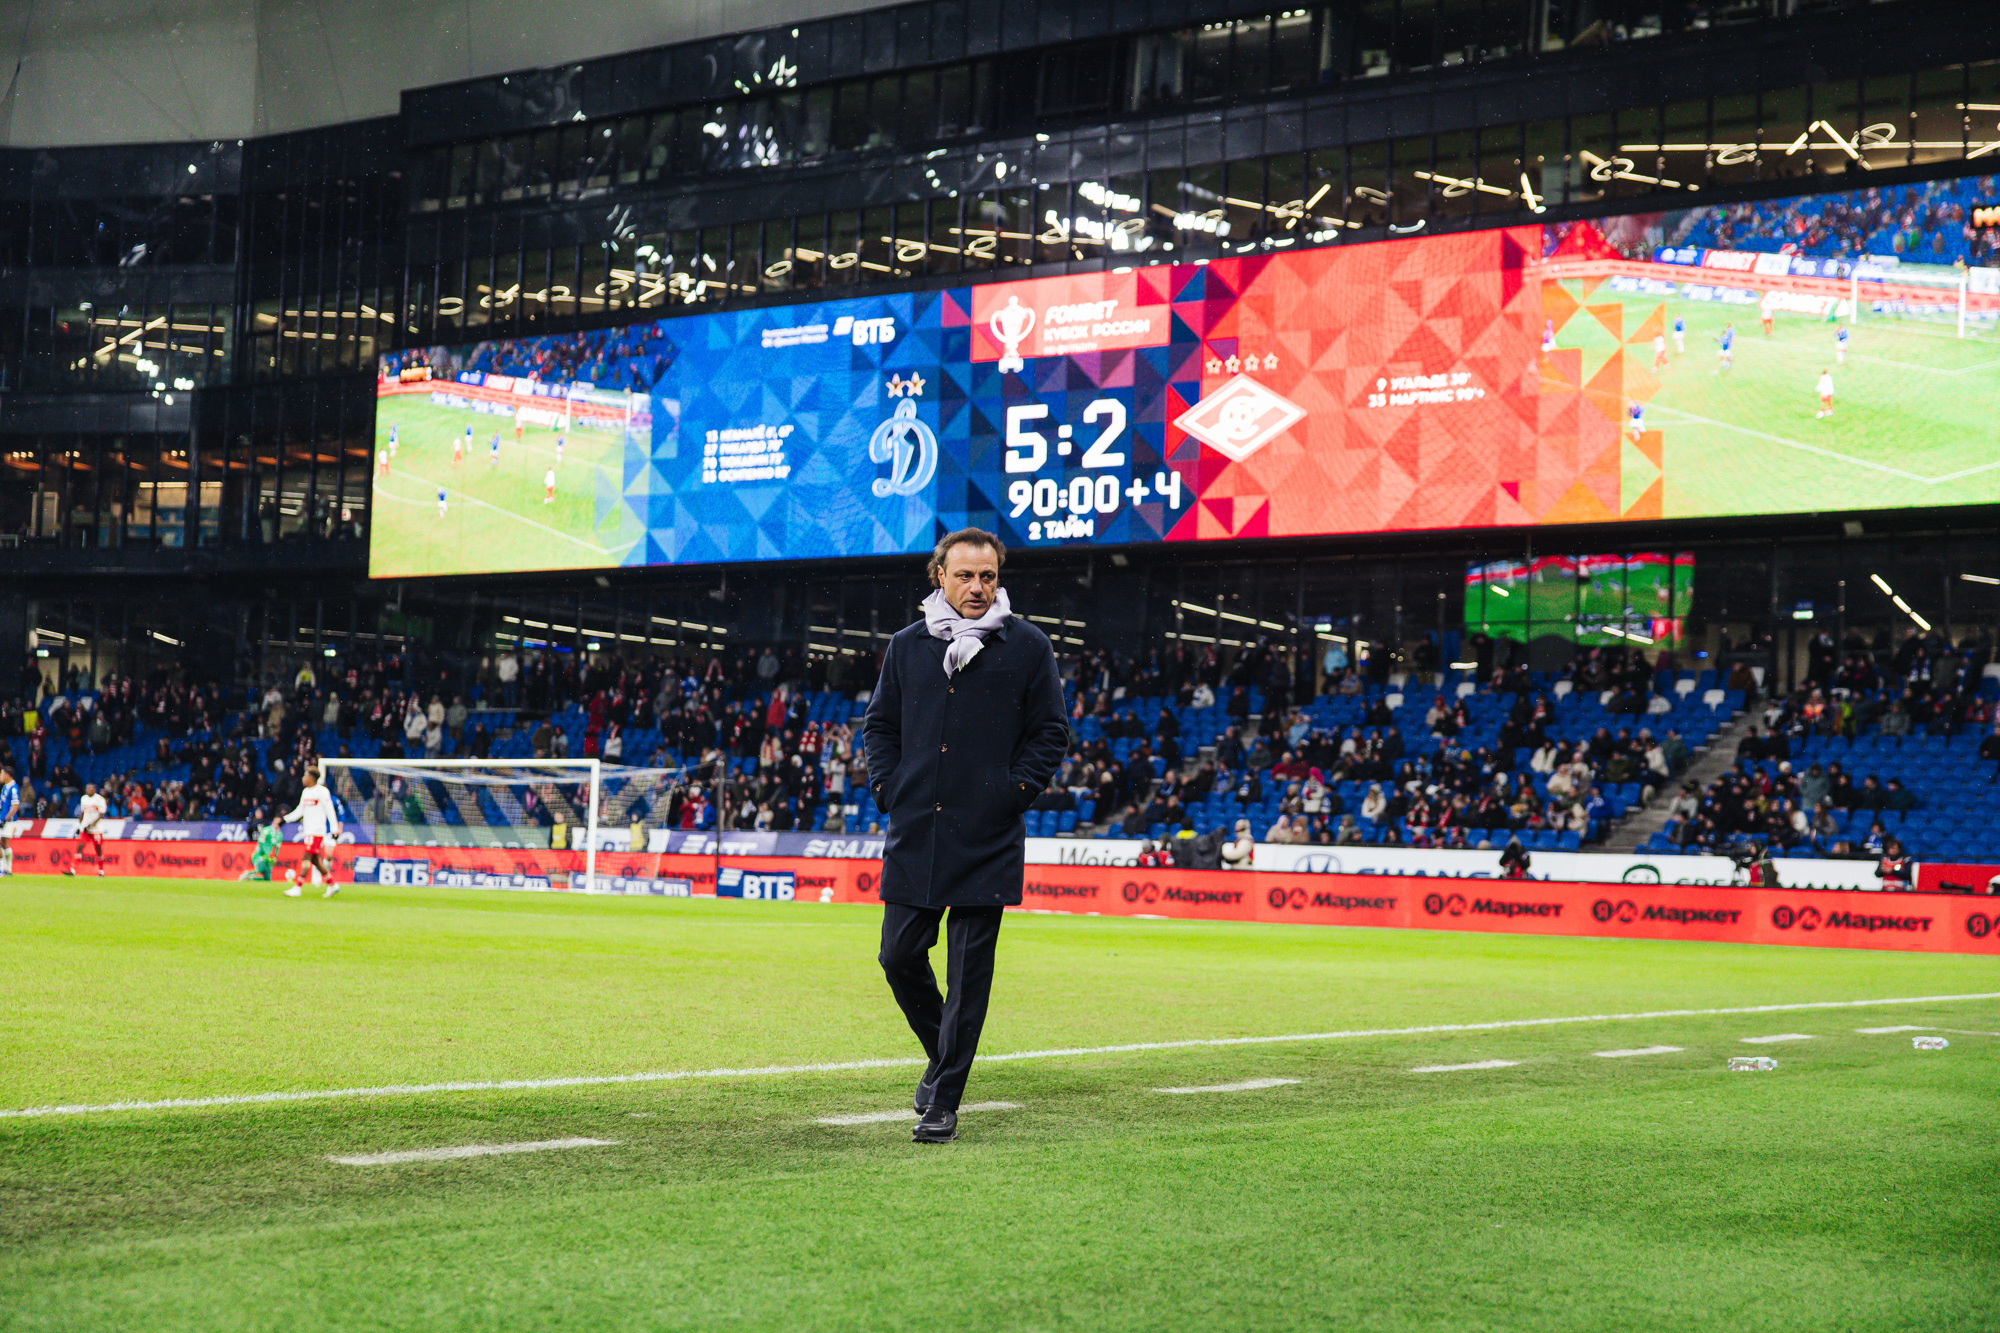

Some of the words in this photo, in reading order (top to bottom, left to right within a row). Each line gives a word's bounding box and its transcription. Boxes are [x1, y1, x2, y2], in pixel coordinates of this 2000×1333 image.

[1044, 300, 1119, 325] FONBET
[852, 317, 896, 346] ВТБ
[1043, 325, 1089, 342] КУБОК
[1091, 318, 1150, 337] РОССИИ
[1028, 522, 1042, 540] 2
[1044, 514, 1095, 539] ТАЙМ
[379, 862, 429, 886] ВТБ
[743, 875, 795, 900] ВТБ
[1025, 882, 1098, 899] Маркет
[1163, 887, 1243, 905] Маркет
[1311, 893, 1397, 911] Маркет
[1470, 899, 1563, 918] Маркет
[1641, 905, 1741, 925] Маркет
[1825, 912, 1933, 932] Маркет
